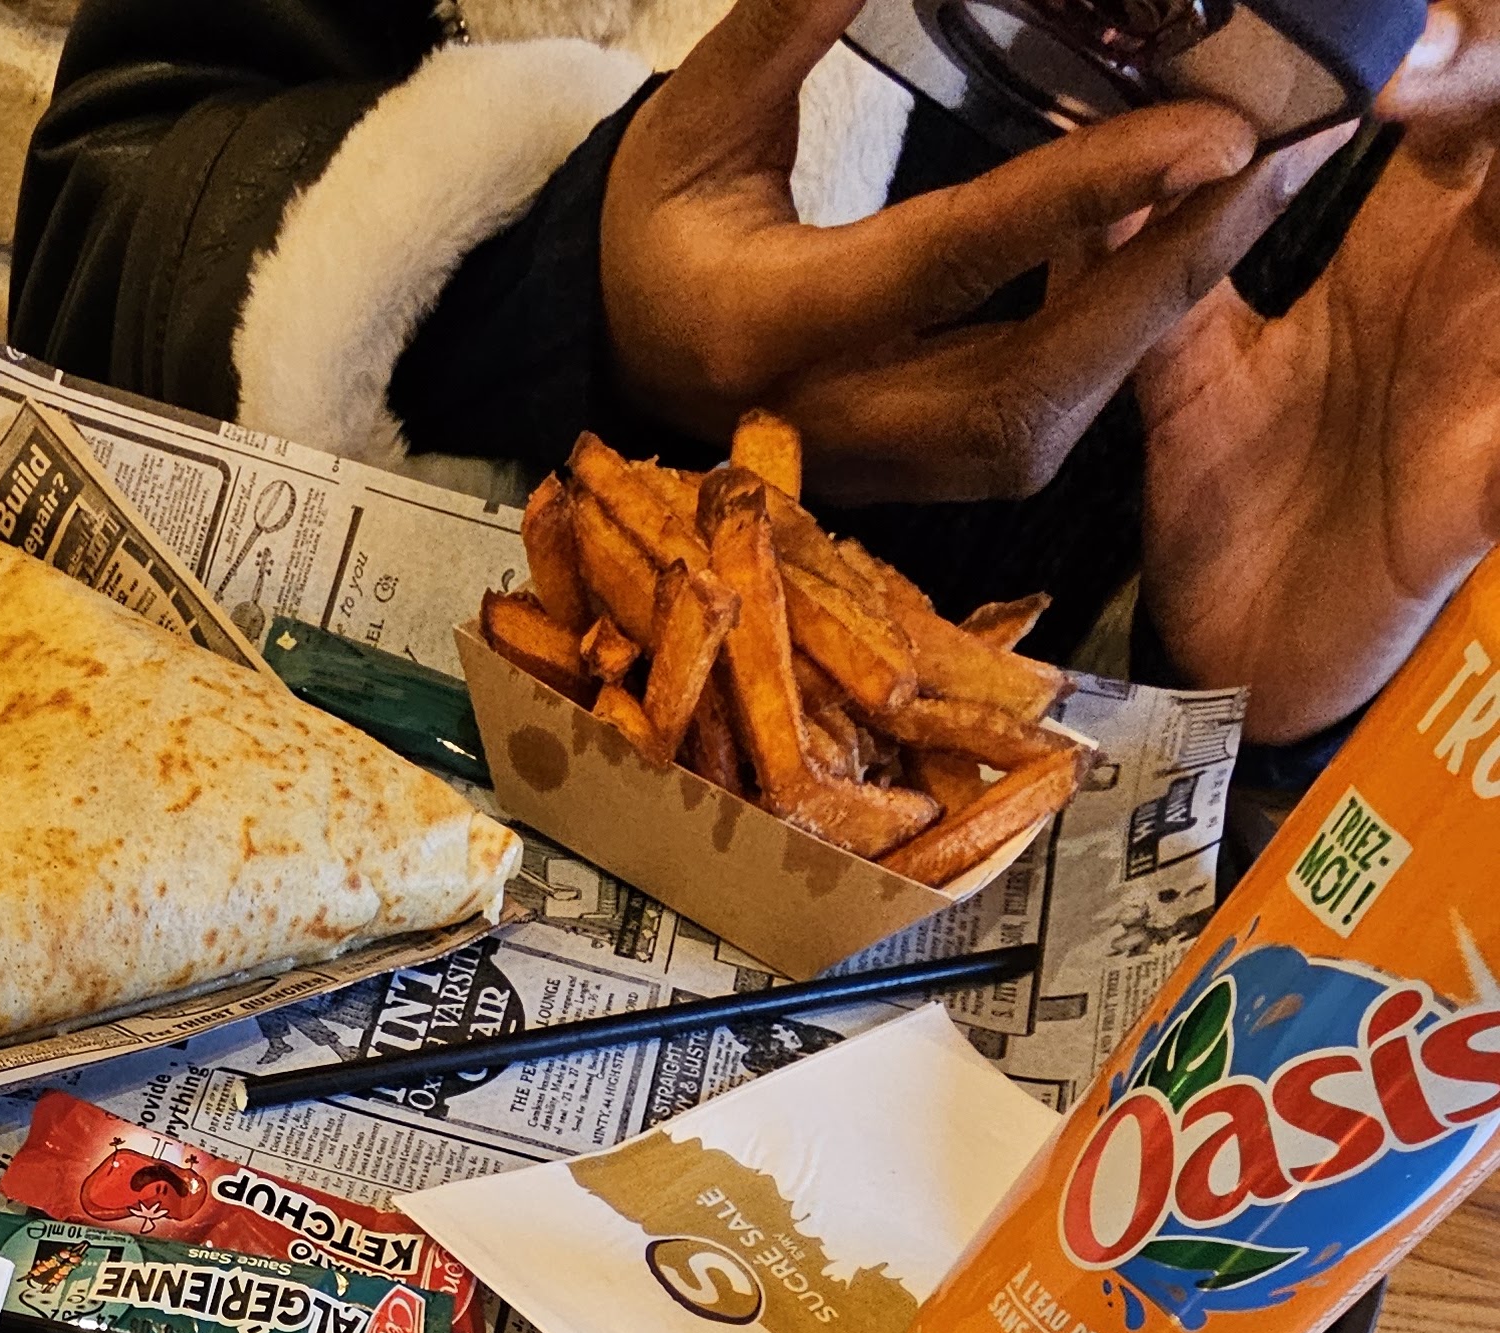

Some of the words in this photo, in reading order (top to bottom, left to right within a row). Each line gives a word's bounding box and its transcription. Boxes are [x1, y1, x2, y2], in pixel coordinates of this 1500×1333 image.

[17, 471, 69, 554] epair?
[339, 596, 355, 618] to
[348, 550, 369, 596] you
[1329, 795, 1392, 872] TRIEZ-
[173, 1007, 235, 1031] THIRST
[239, 972, 327, 1014] QUENCHER
[1061, 993, 1500, 1267] Oasis
[217, 1169, 415, 1271] KETCHUP
[695, 1187, 765, 1248] SALÉ
[188, 1248, 233, 1265] Saus
[233, 1255, 292, 1276] Sauce
[752, 1244, 840, 1323] SUCRÉ
[1011, 1261, 1032, 1290] À
[1019, 1279, 1071, 1331] L'EAU
